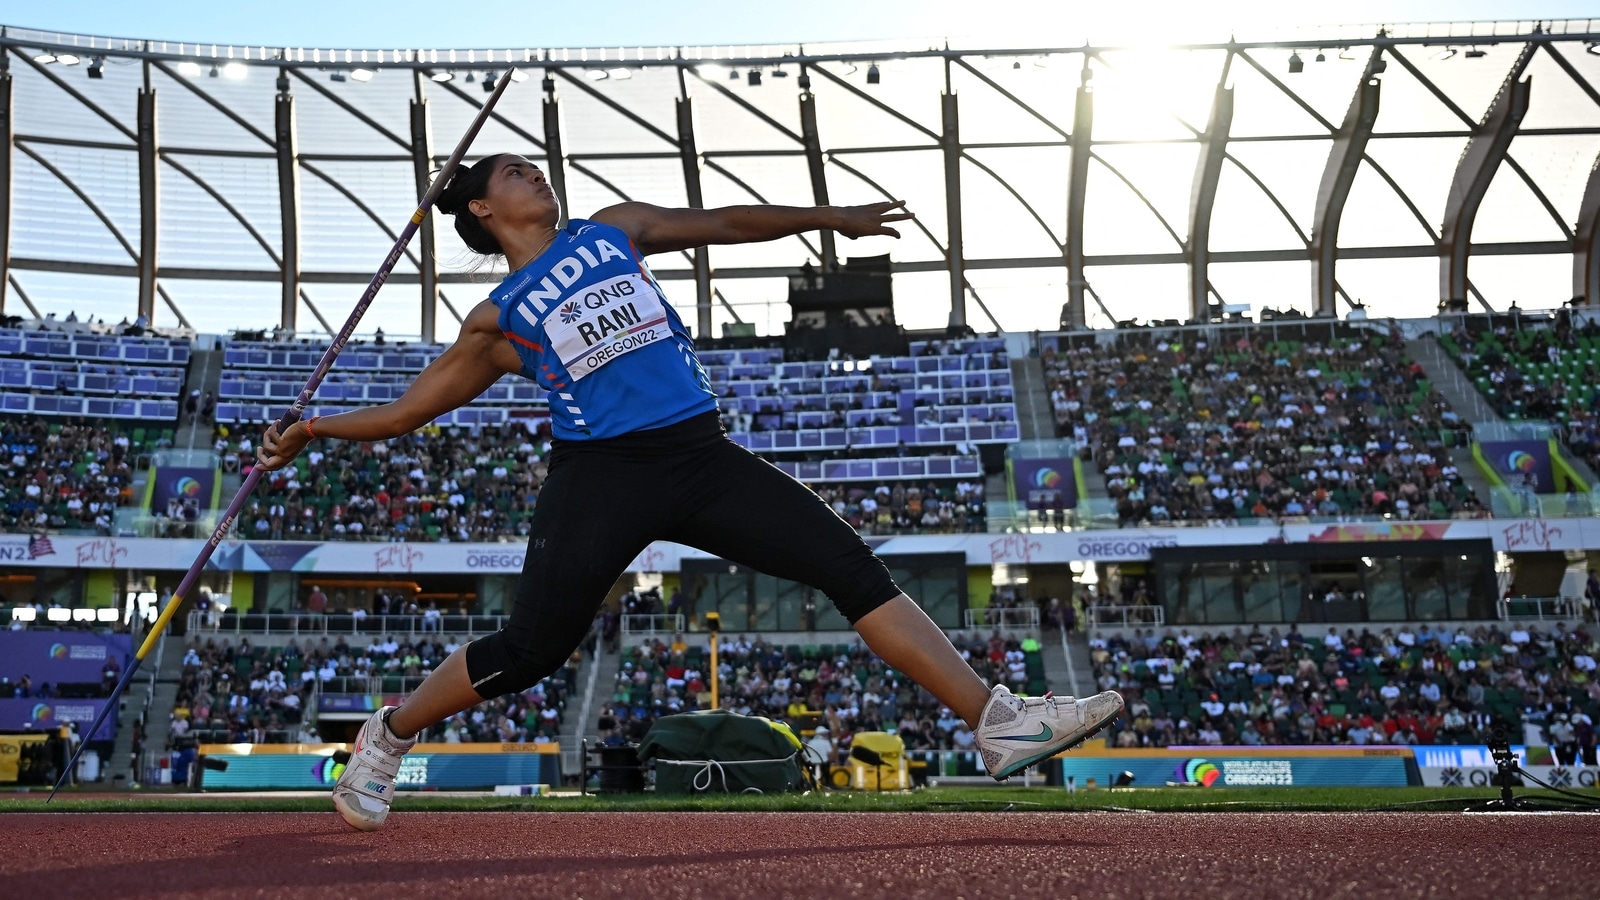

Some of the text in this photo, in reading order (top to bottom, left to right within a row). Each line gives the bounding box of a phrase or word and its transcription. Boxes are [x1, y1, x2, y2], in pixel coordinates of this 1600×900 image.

[516, 238, 628, 327] INDIA
[584, 280, 635, 310] QNB
[577, 302, 642, 347] RANI
[586, 329, 658, 368] OREGON22
[0, 546, 36, 560] N2
[466, 555, 524, 568] OREGO
[364, 780, 387, 794] NIKE
